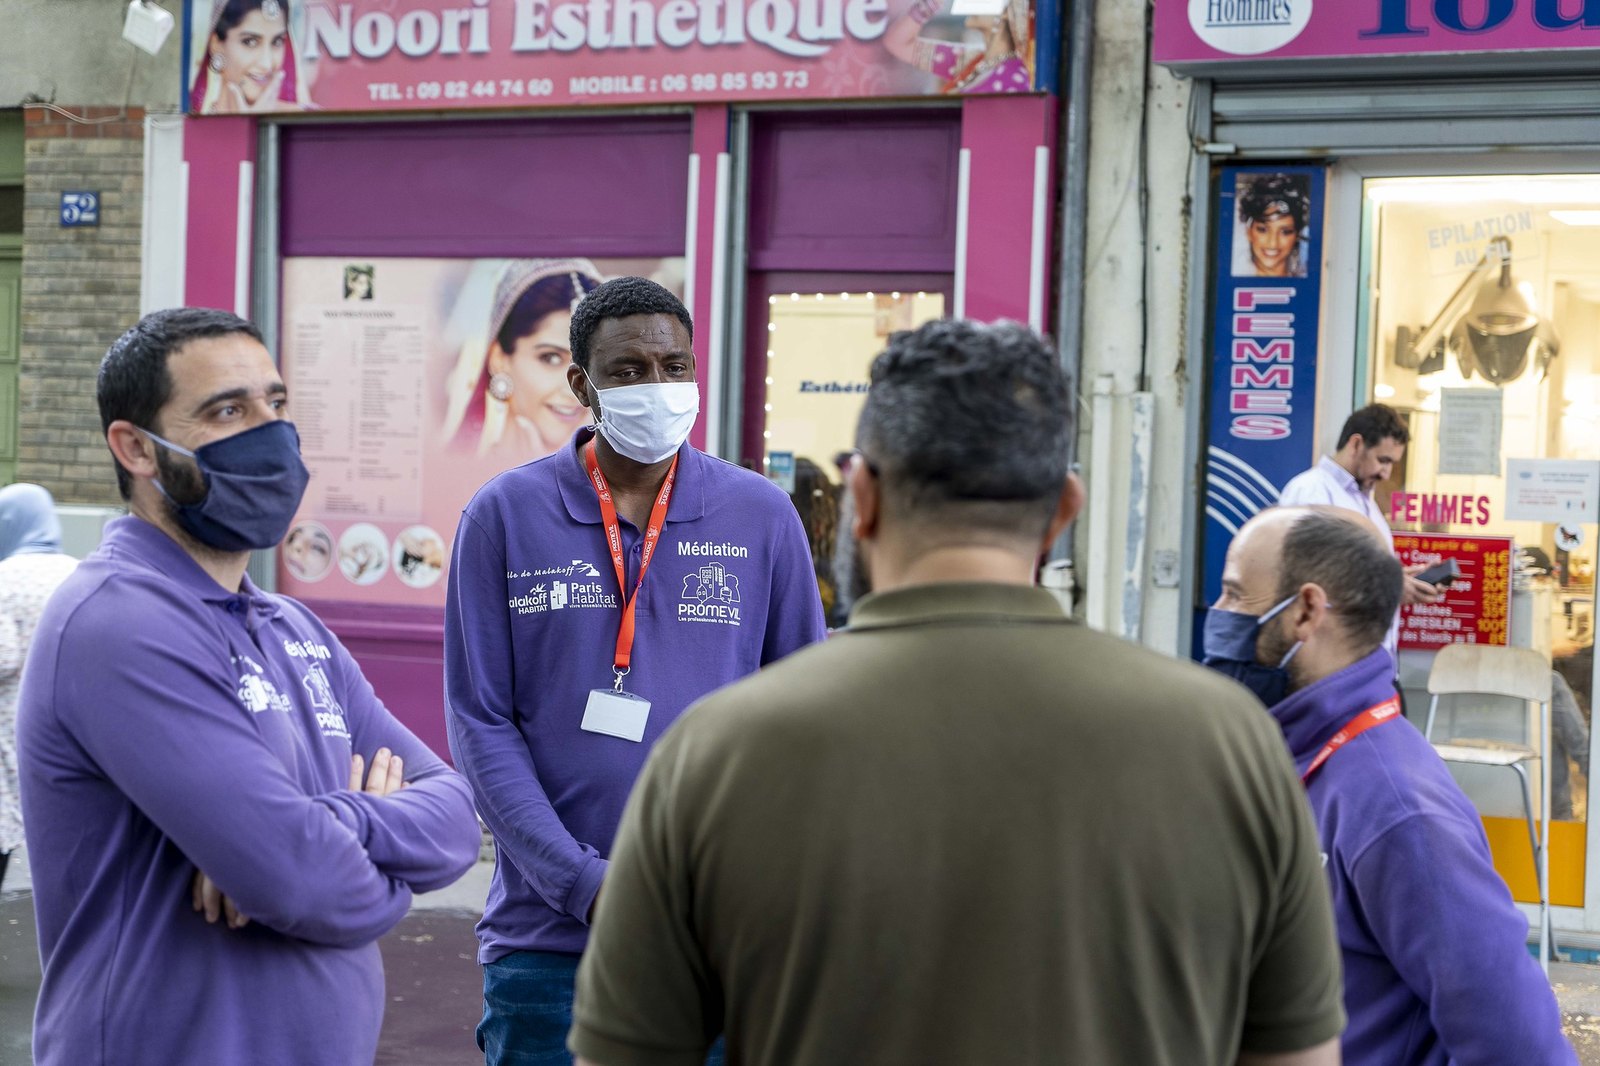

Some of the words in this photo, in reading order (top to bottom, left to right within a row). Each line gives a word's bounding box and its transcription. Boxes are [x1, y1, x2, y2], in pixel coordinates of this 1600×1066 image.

[1206, 0, 1292, 21] Hommes
[303, 0, 491, 58] Noori
[368, 83, 403, 100] TEL
[417, 81, 441, 99] 09
[444, 81, 468, 98] 82
[471, 79, 496, 97] 44
[499, 79, 524, 96] 74
[568, 75, 646, 95] MOBILE
[661, 73, 688, 92] 06
[691, 73, 717, 92] 98
[721, 72, 748, 90] 85
[751, 70, 778, 90] 93
[782, 70, 809, 89] 73
[1428, 211, 1532, 249] EPILATION
[1455, 248, 1478, 267] AU
[1229, 287, 1297, 441] FEMMES
[799, 381, 873, 393] Esthéti
[1391, 491, 1491, 525] FEMMES
[678, 541, 748, 558] Médiation
[520, 569, 532, 577] de
[533, 566, 575, 577] Malakoff
[571, 582, 603, 593] Paris
[509, 592, 548, 608] alakoff
[571, 592, 616, 604] Habitat
[518, 604, 548, 615] HABITAT
[678, 603, 741, 621] PROMEVIL
